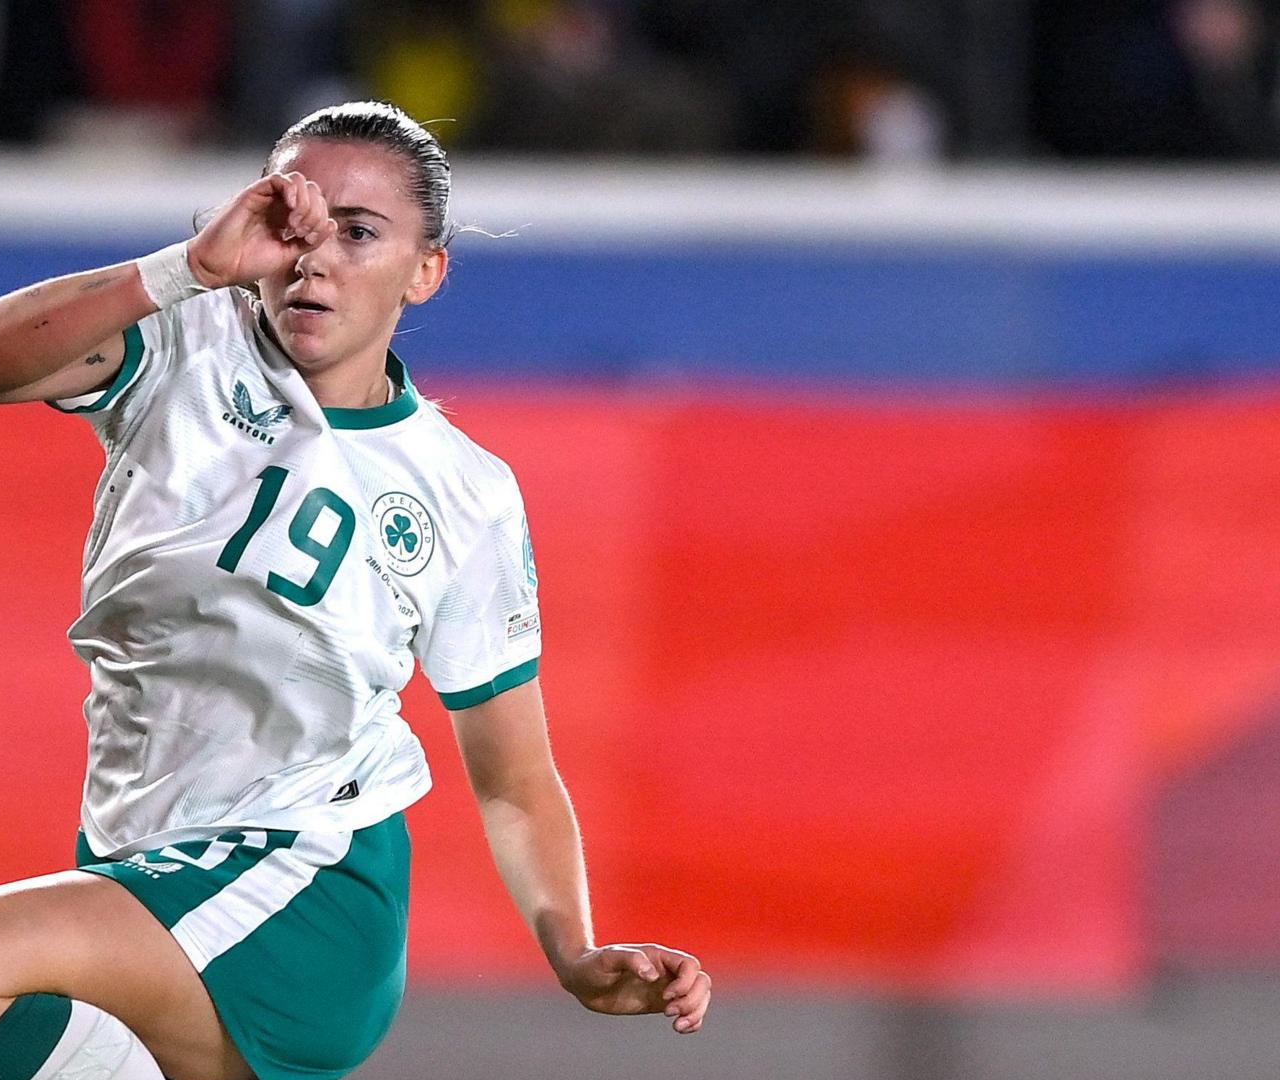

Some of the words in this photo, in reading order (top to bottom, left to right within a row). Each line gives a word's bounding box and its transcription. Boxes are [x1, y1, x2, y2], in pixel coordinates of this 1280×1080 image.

[222, 412, 275, 445] CASTORE
[216, 465, 356, 607] 19
[382, 497, 431, 544] IRELAND
